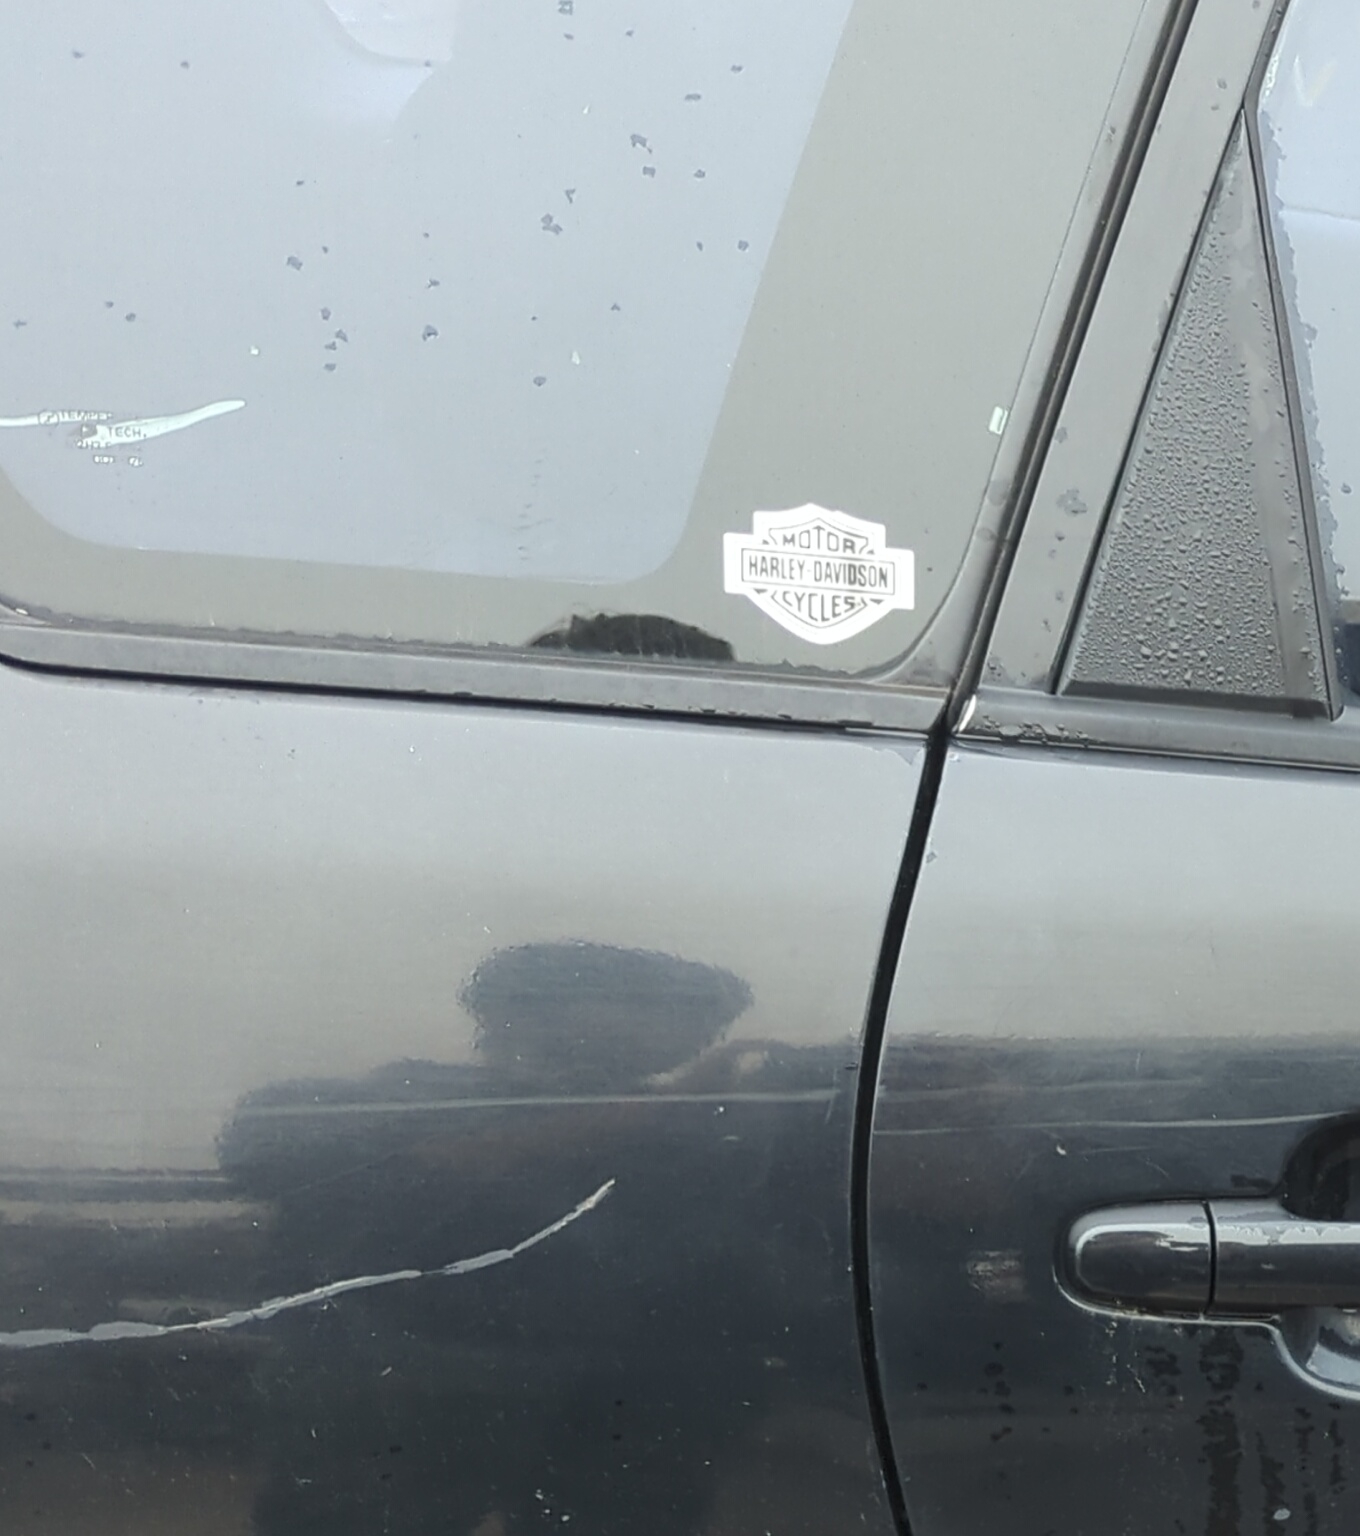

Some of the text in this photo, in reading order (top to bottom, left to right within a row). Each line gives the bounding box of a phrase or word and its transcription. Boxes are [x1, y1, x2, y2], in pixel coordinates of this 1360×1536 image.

[783, 526, 856, 554] MOTOR
[749, 555, 888, 588] HARLEY-DAVIDSON
[782, 590, 856, 622] CYCLES
